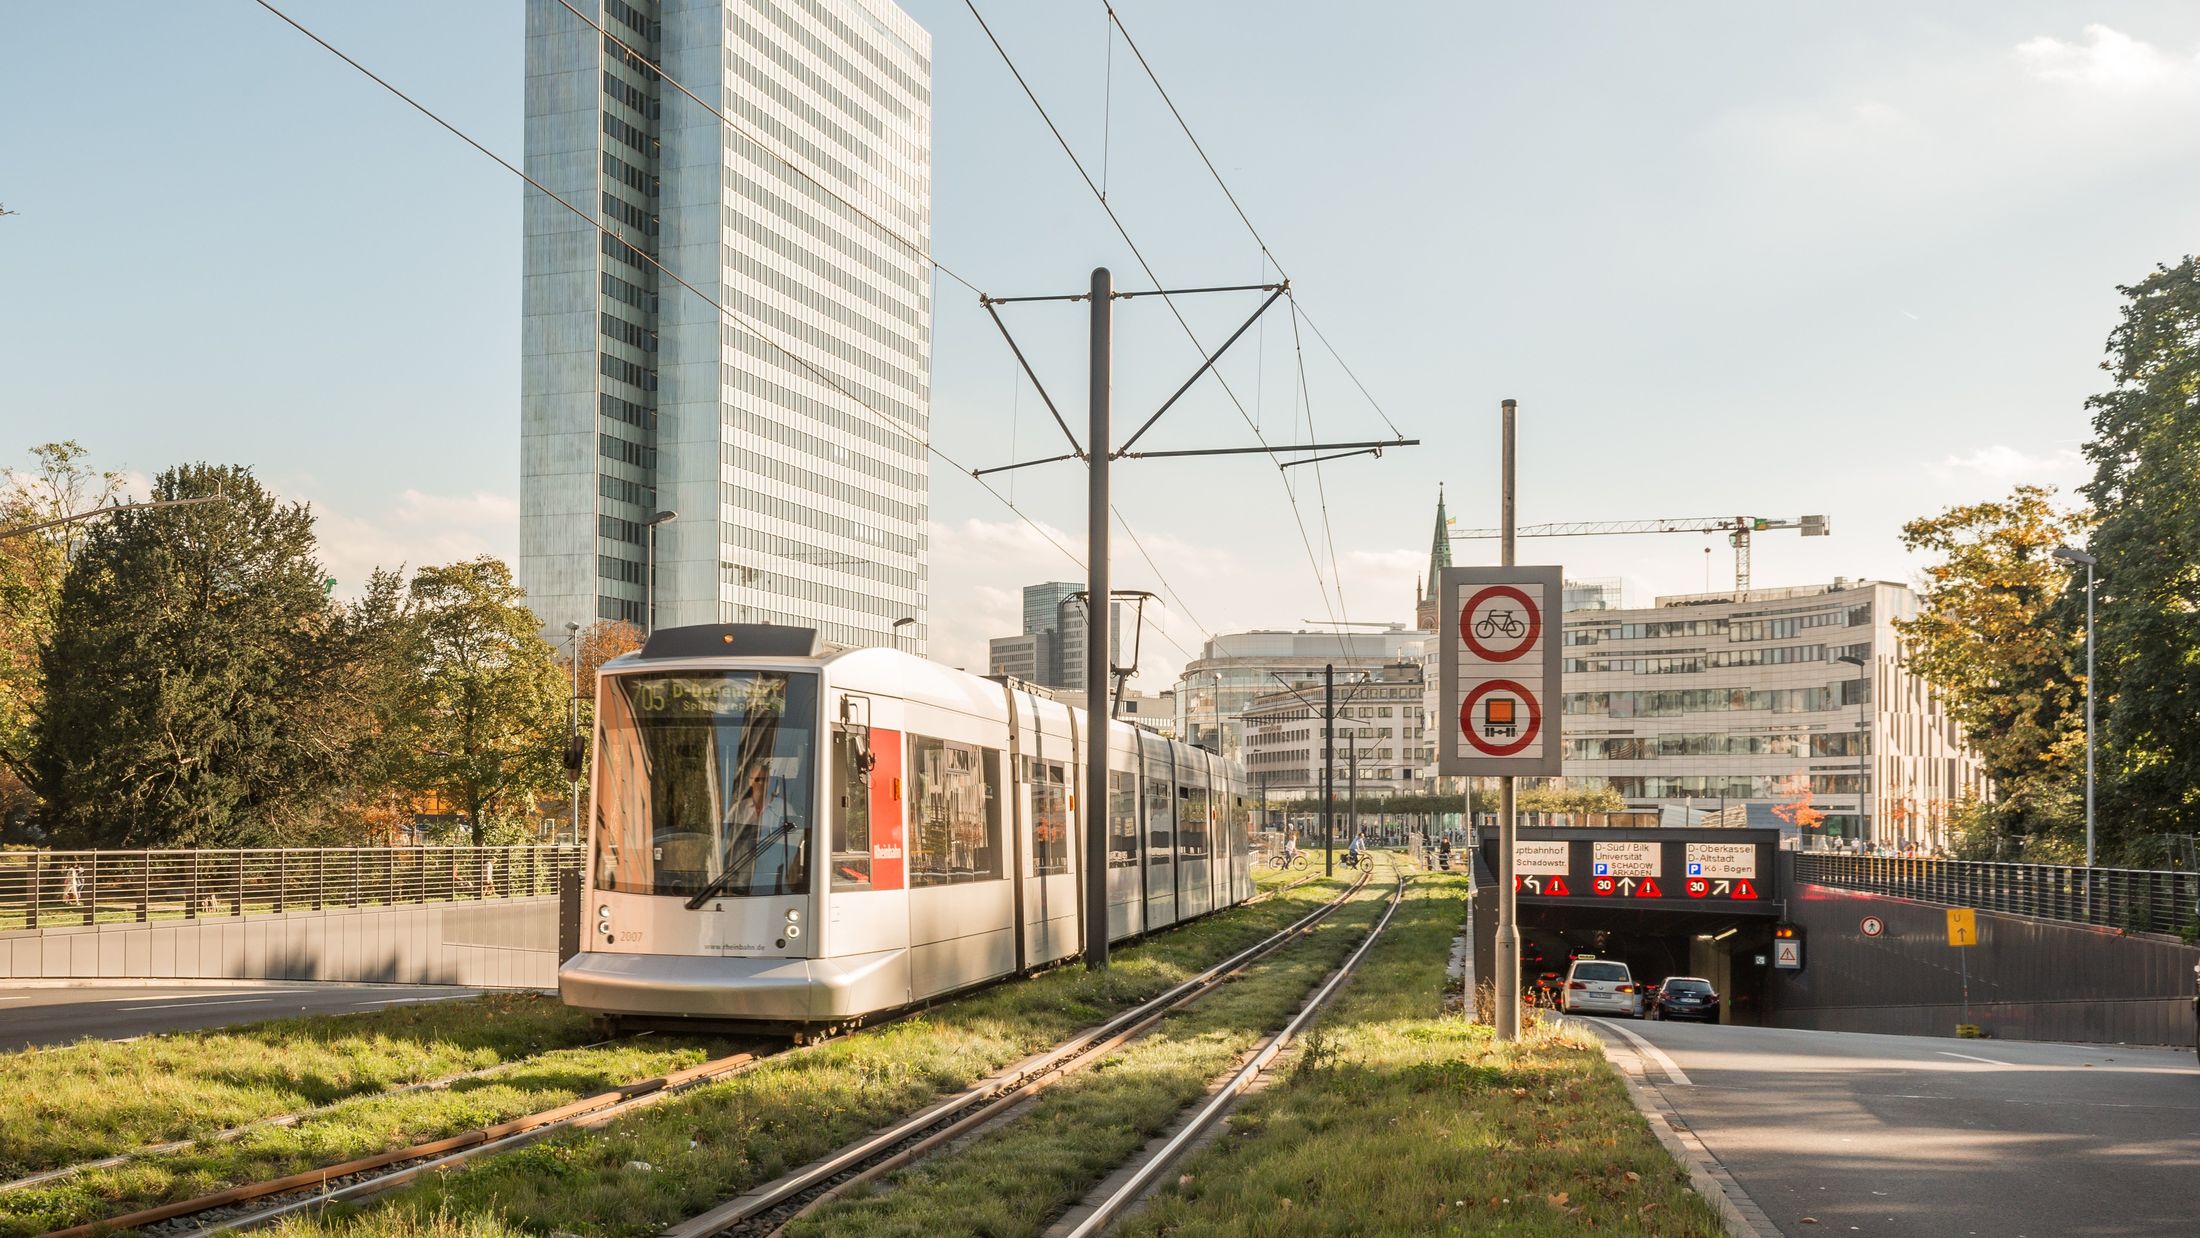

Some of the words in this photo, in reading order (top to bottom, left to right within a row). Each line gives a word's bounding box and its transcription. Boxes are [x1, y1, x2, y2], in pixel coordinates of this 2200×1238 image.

[1633, 843, 1649, 852] Bilk
[1688, 844, 1753, 853] D-Oberkassel
[1595, 853, 1642, 861] Universität
[1688, 854, 1734, 862] D-Altstadt
[1597, 881, 1611, 890] 30
[1690, 882, 1705, 891] 30
[620, 931, 643, 942] 2007
